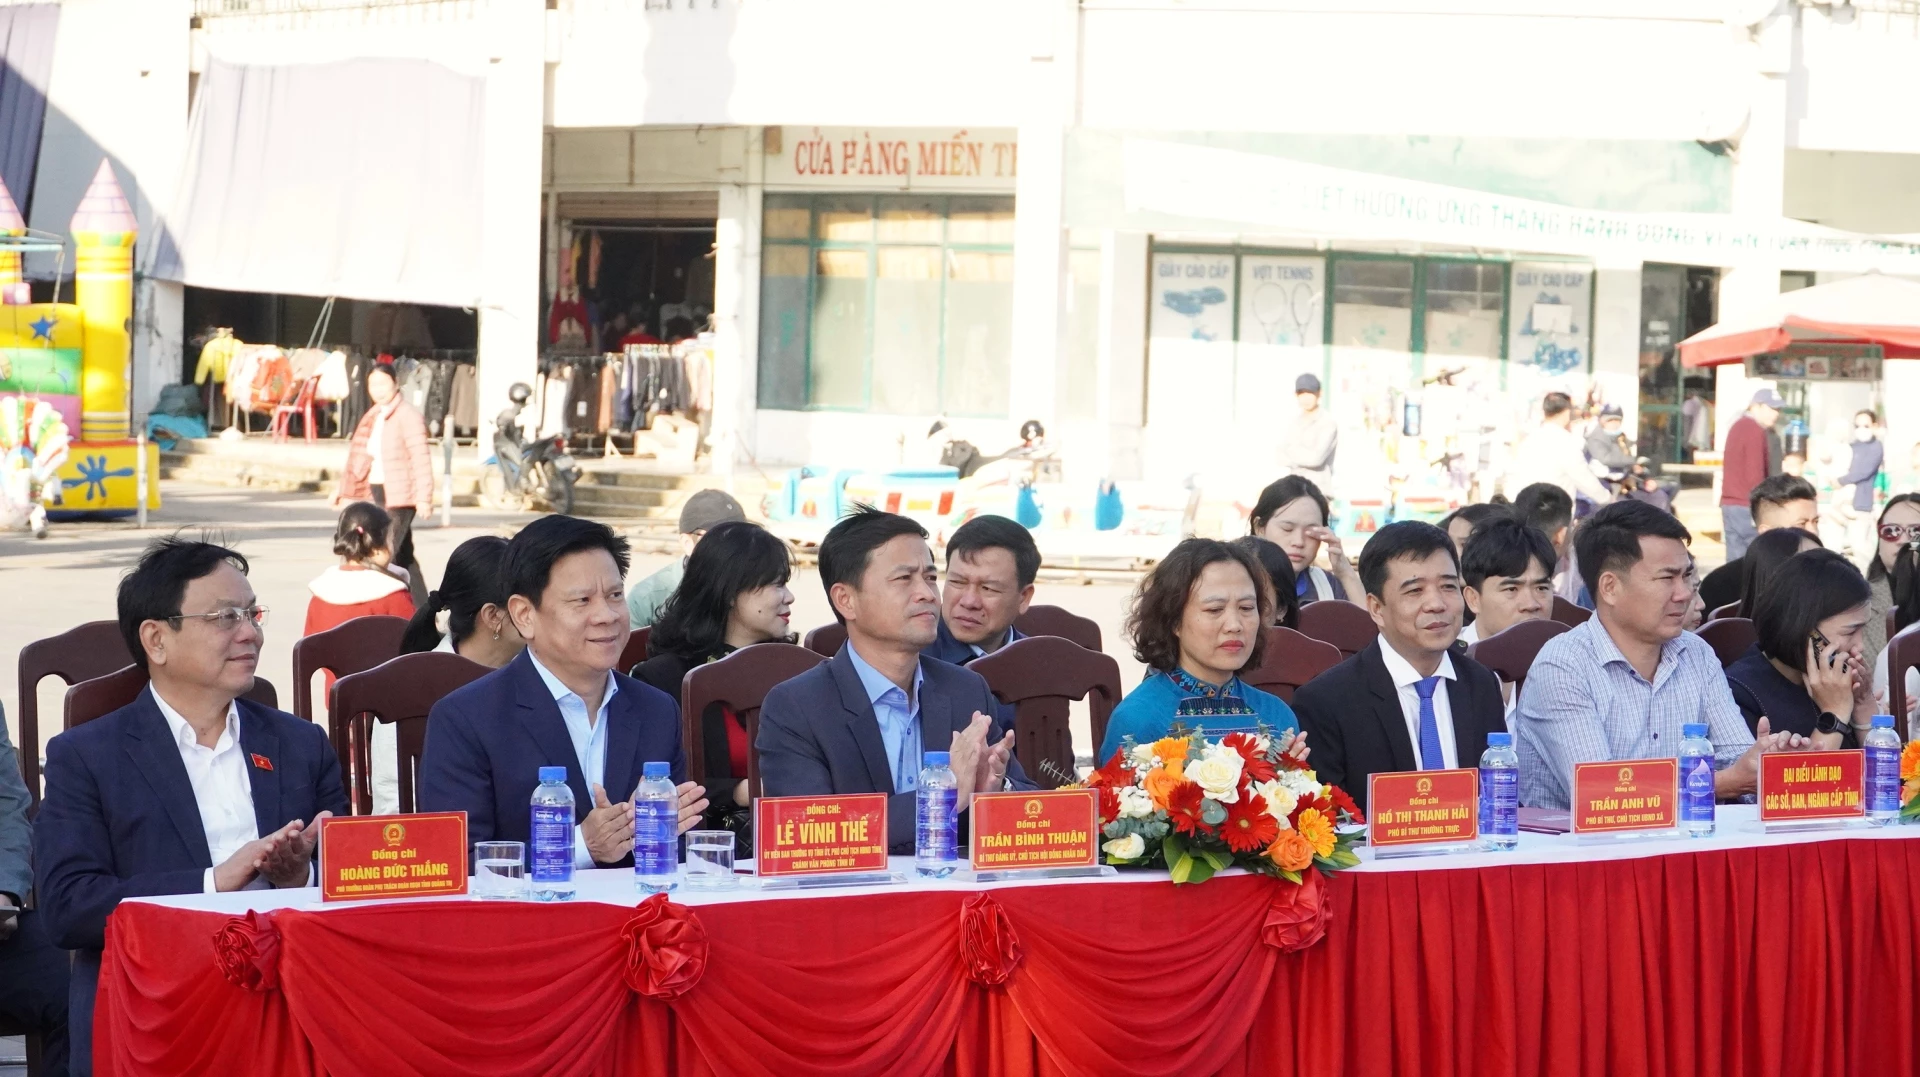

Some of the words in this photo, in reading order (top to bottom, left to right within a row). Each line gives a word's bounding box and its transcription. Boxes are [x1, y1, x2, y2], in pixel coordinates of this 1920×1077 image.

[795, 126, 834, 175] CỬA
[842, 131, 908, 175] HÀNG
[917, 129, 983, 177] MIỀN
[1784, 768, 1794, 786] ĐẠI
[1795, 761, 1810, 782] BIỂU
[1811, 763, 1828, 782] LÃNH
[1829, 766, 1842, 784] ĐẠO
[1590, 796, 1618, 811] TRẦN
[1621, 798, 1644, 809] ANH
[1647, 795, 1660, 807] VŨ
[1766, 792, 1779, 810] CÁC
[1808, 790, 1829, 808] NGÀNH
[1830, 786, 1843, 807] CẤP
[806, 803, 825, 815] ĐỒNG
[1378, 809, 1392, 824] HỒ
[1396, 811, 1411, 824] THỊ
[1414, 809, 1449, 822] THANH
[1452, 804, 1468, 819] HẢI
[777, 819, 794, 846] LÊ
[799, 818, 836, 844] VĨNH
[840, 813, 868, 842] THẾ
[1016, 820, 1036, 829] Đồng
[1038, 819, 1050, 828] chí
[1388, 827, 1399, 837] PHÓ
[1408, 826, 1420, 835] THƯ
[980, 831, 1012, 847] TRẦN
[1015, 832, 1044, 846] BÌNH
[1047, 830, 1086, 846] THUẬN
[372, 849, 398, 860] Đồng
[401, 848, 416, 858] chí
[340, 865, 380, 881] HOÀNG
[383, 863, 407, 878] ĐỨC
[410, 860, 448, 876] THẮNG
